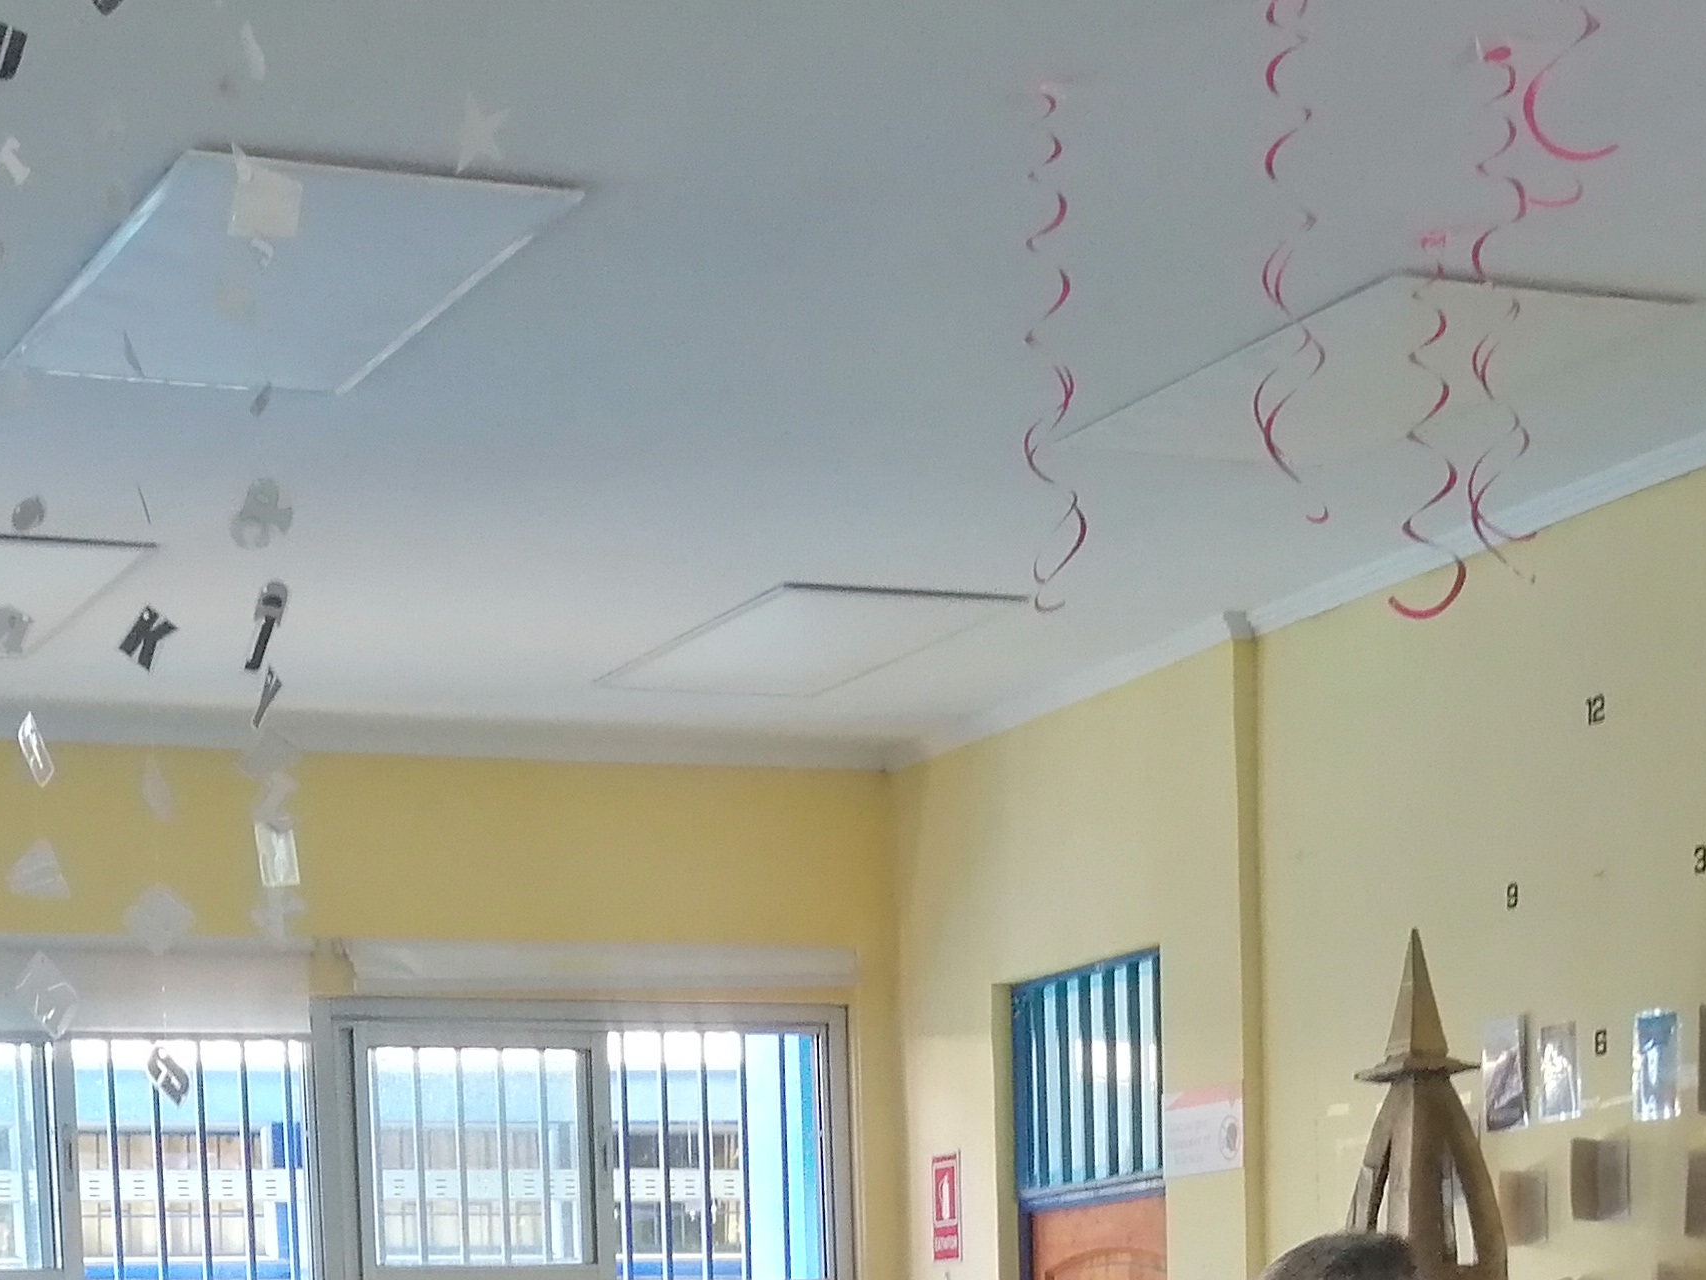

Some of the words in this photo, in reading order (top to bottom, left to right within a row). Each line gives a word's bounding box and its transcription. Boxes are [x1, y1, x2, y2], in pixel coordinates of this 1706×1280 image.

[1585, 693, 1606, 725] 12
[1506, 882, 1519, 910] 9
[1595, 1029, 1607, 1055] 6
